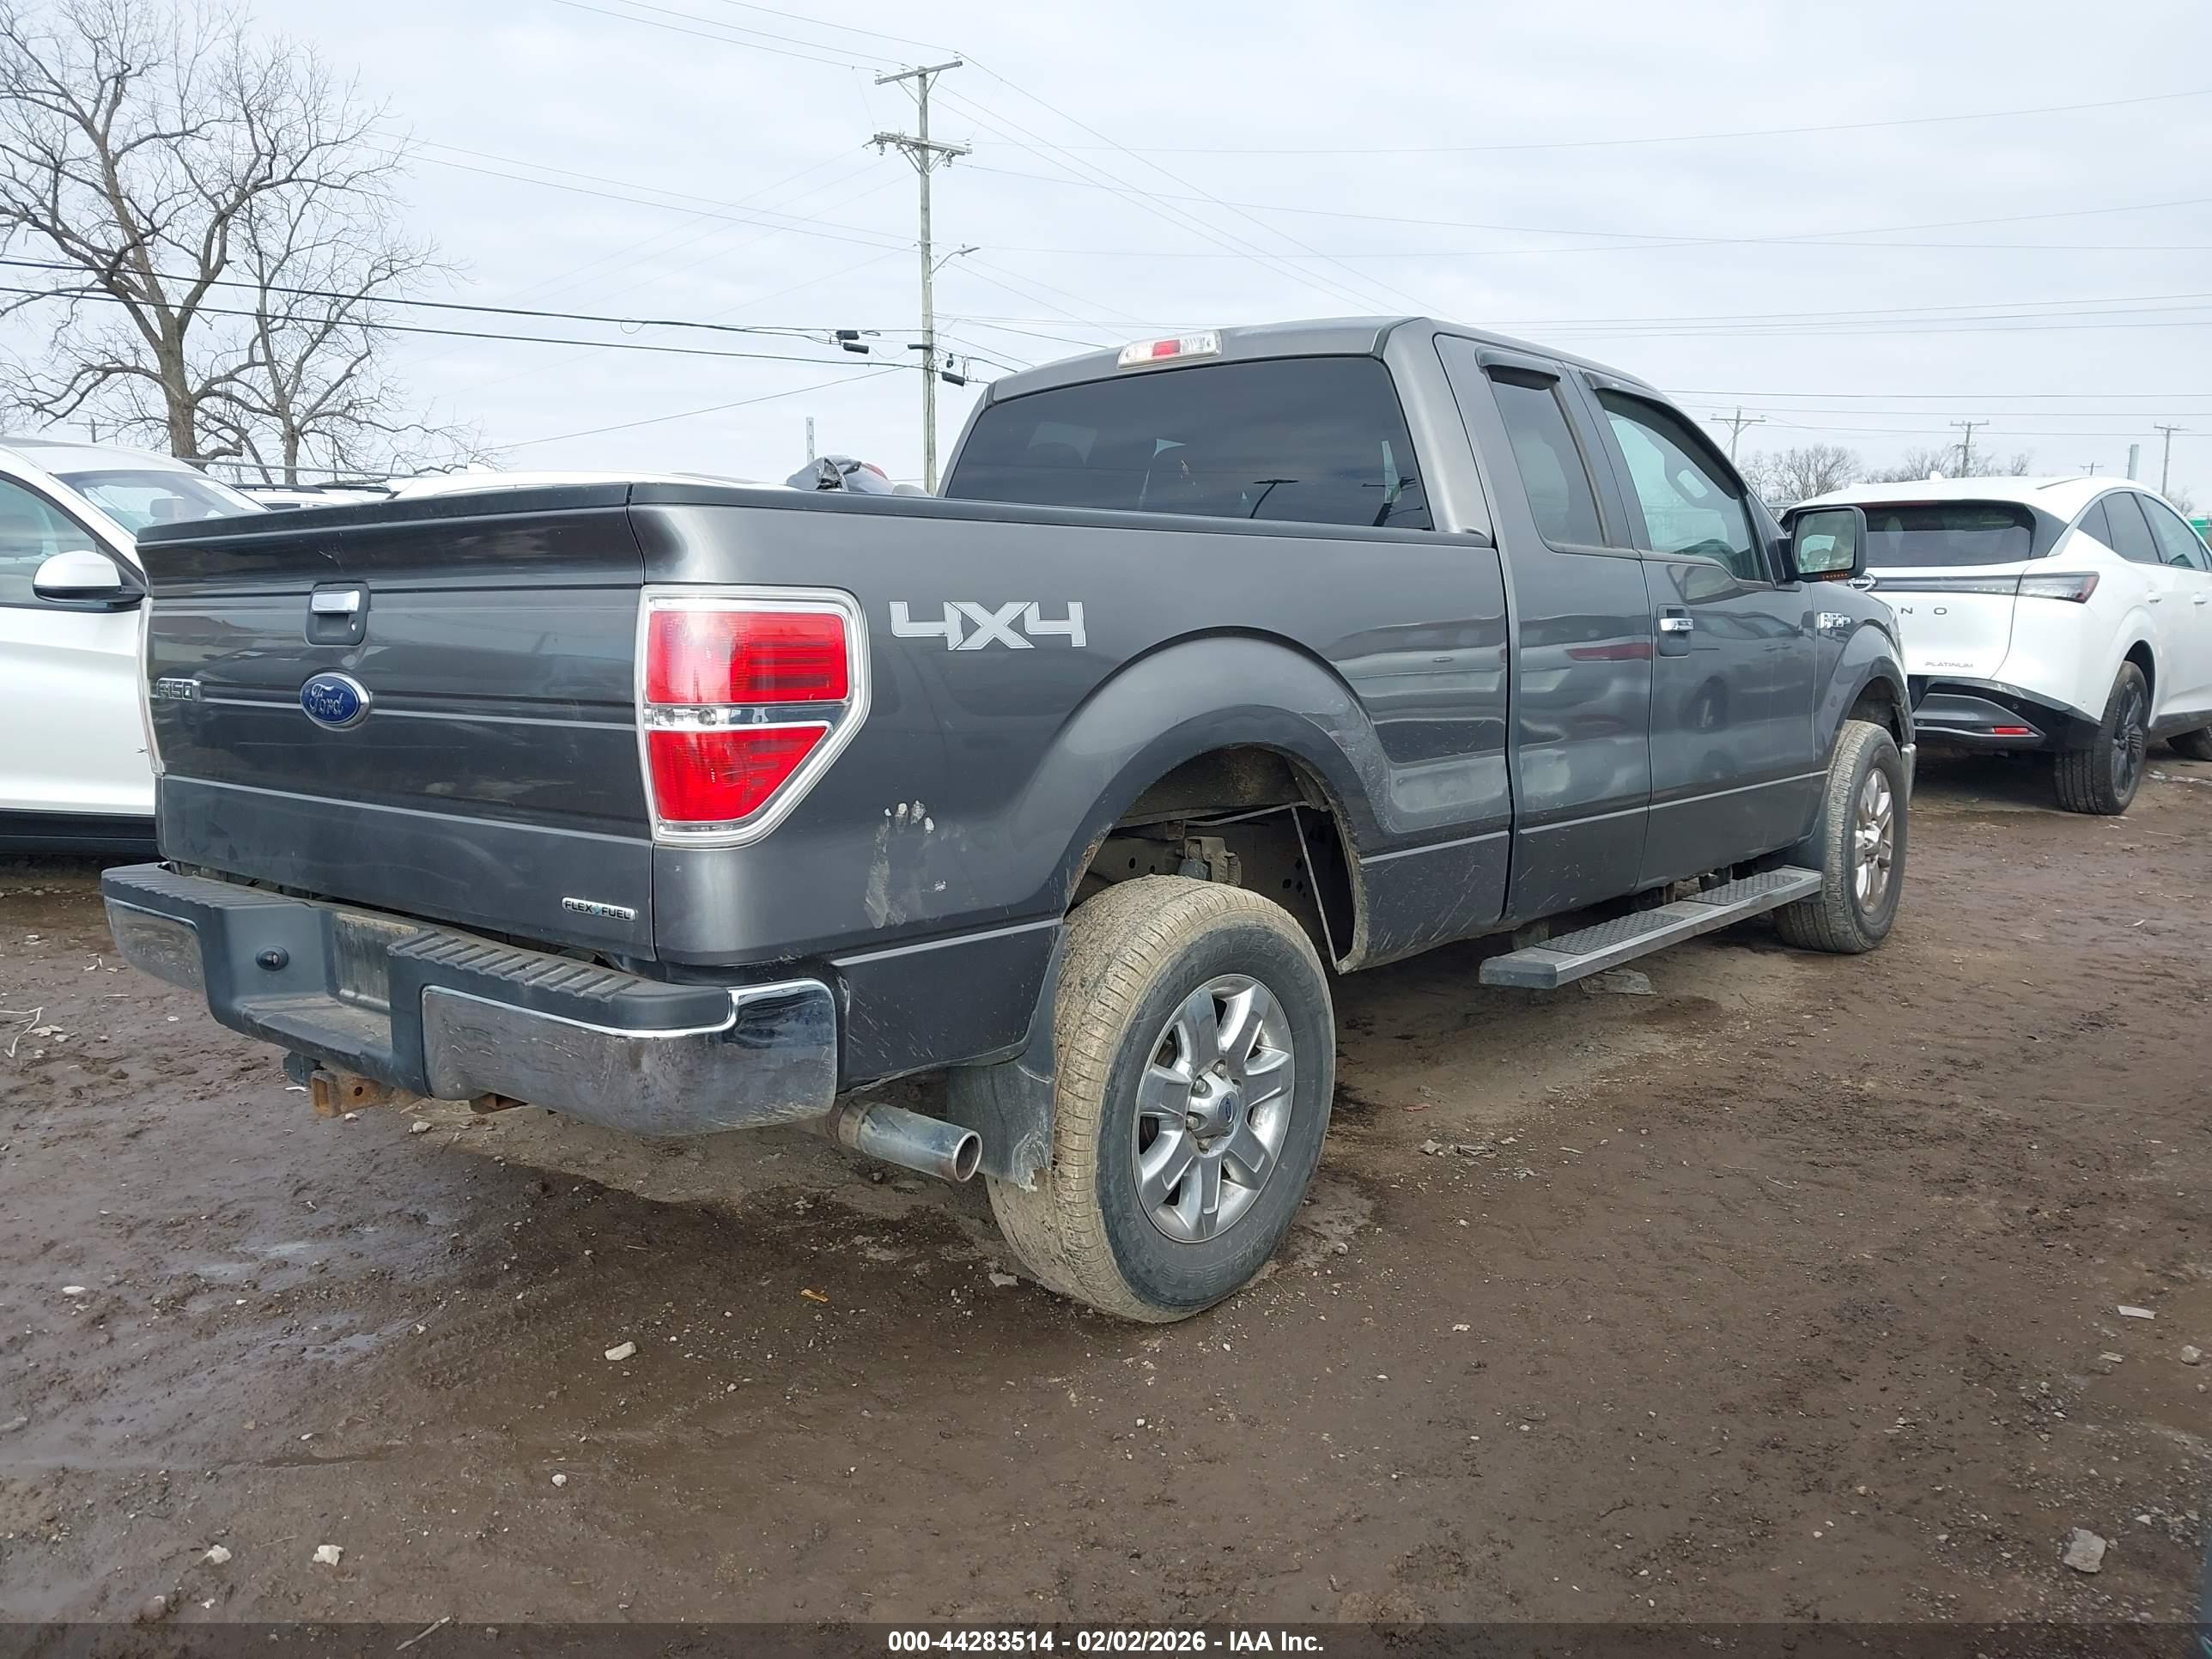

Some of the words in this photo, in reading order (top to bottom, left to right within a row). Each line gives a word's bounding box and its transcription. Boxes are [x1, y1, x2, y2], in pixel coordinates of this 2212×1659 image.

[889, 601, 1086, 651] 4X4
[309, 684, 343, 715] Ford
[565, 900, 592, 914] FLEX
[601, 907, 630, 920] FUEL
